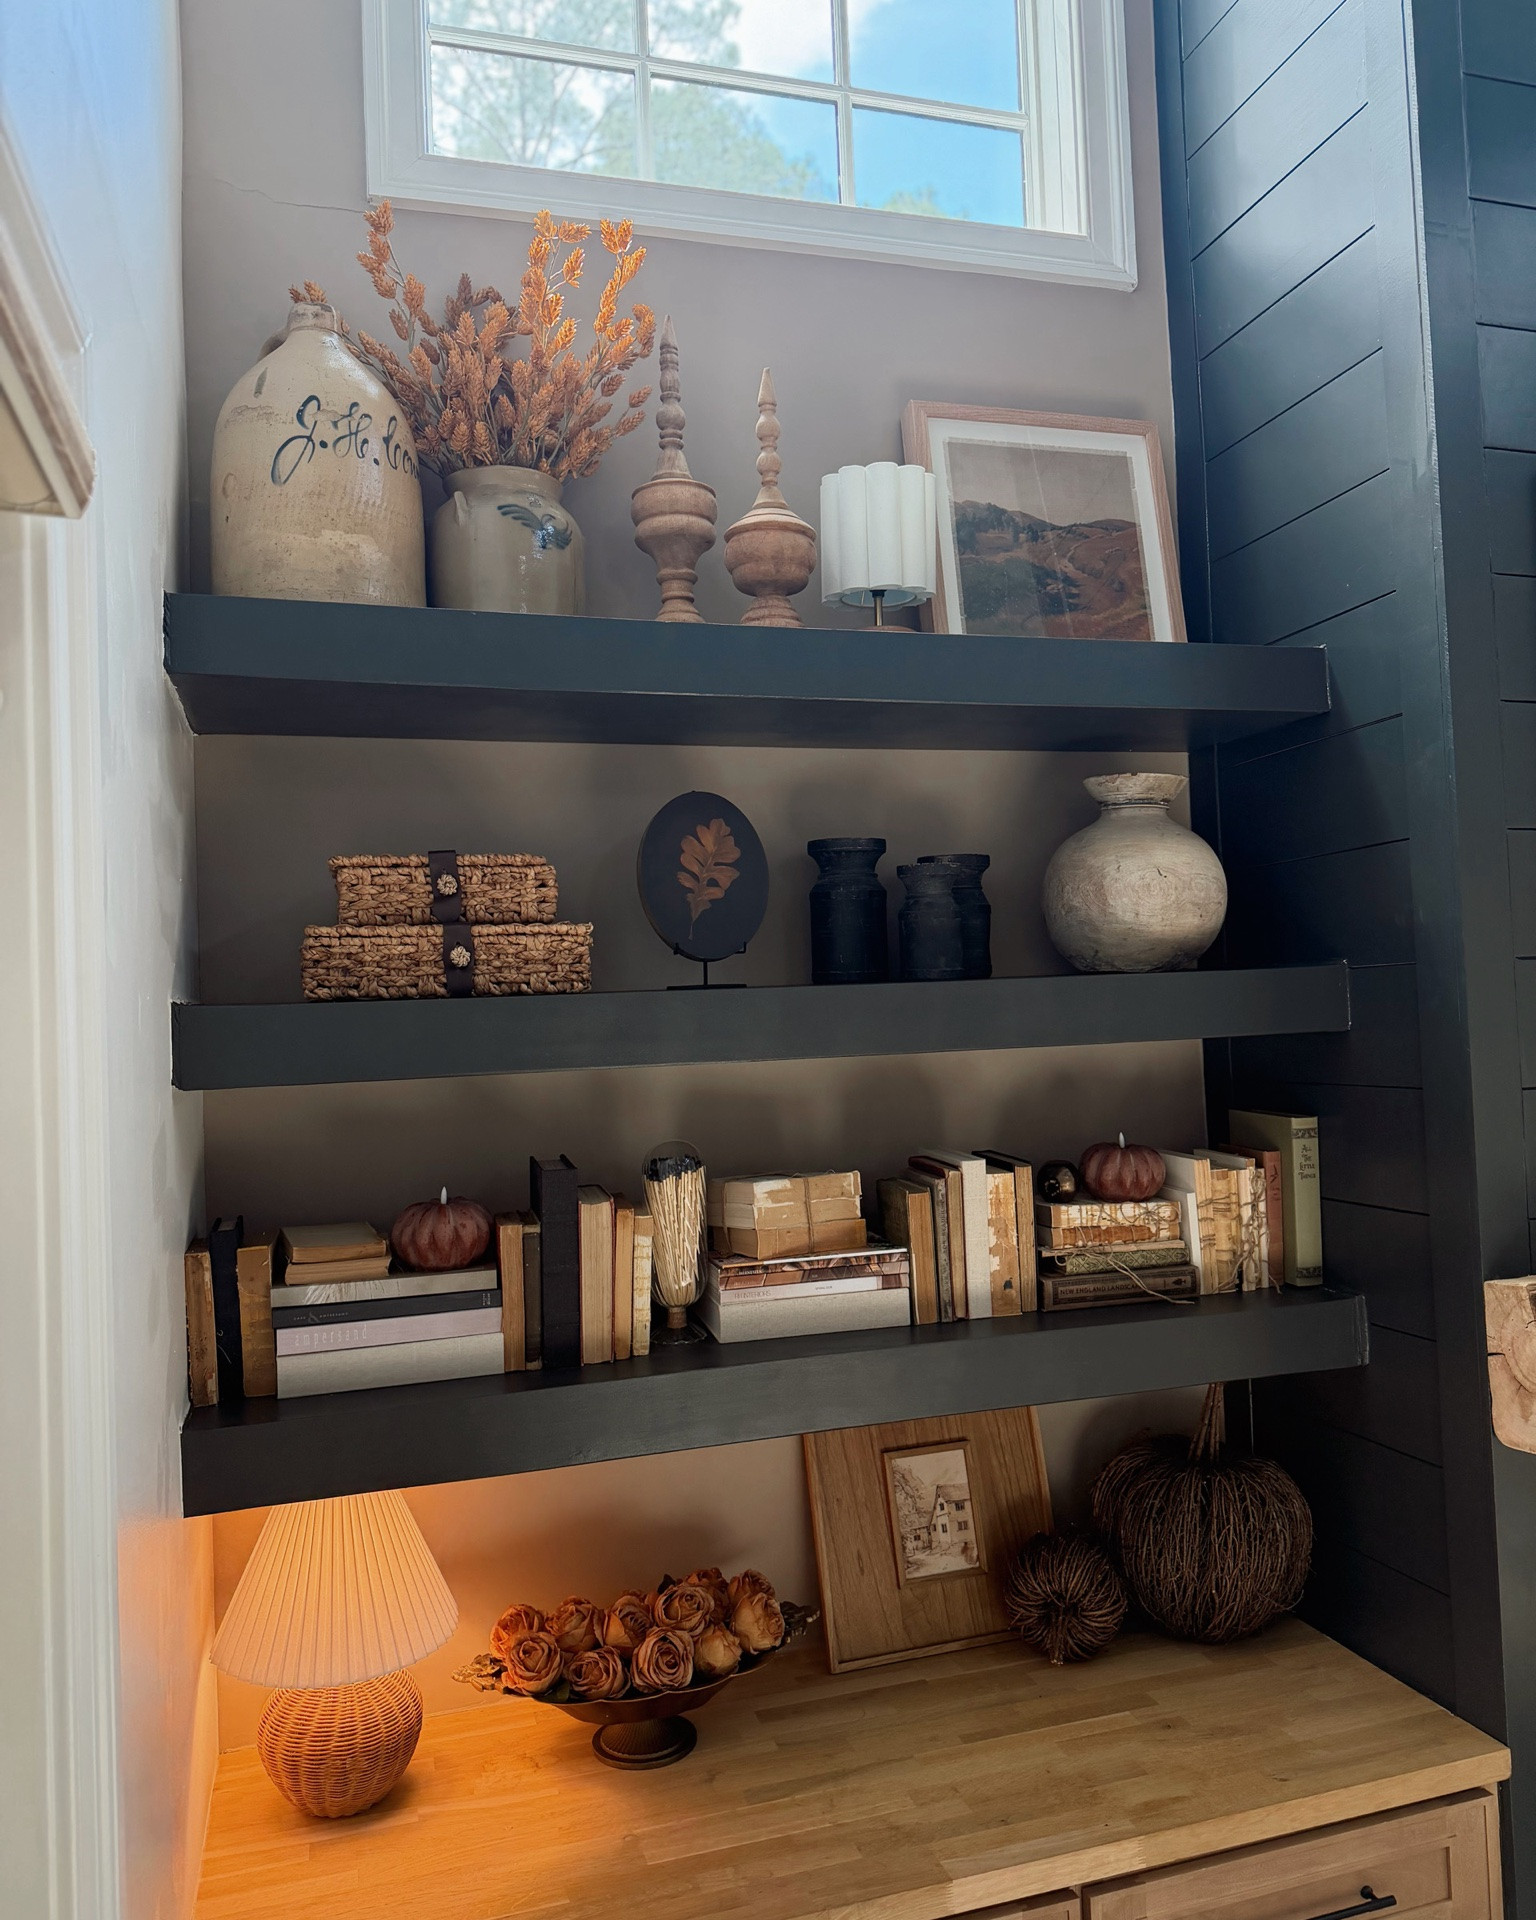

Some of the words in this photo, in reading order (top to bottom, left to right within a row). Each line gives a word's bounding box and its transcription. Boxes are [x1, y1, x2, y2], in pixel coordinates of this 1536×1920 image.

[1059, 1288, 1075, 1296] NEW
[1076, 1285, 1106, 1294] ENGLAND
[294, 1322, 367, 1349] ampersand
